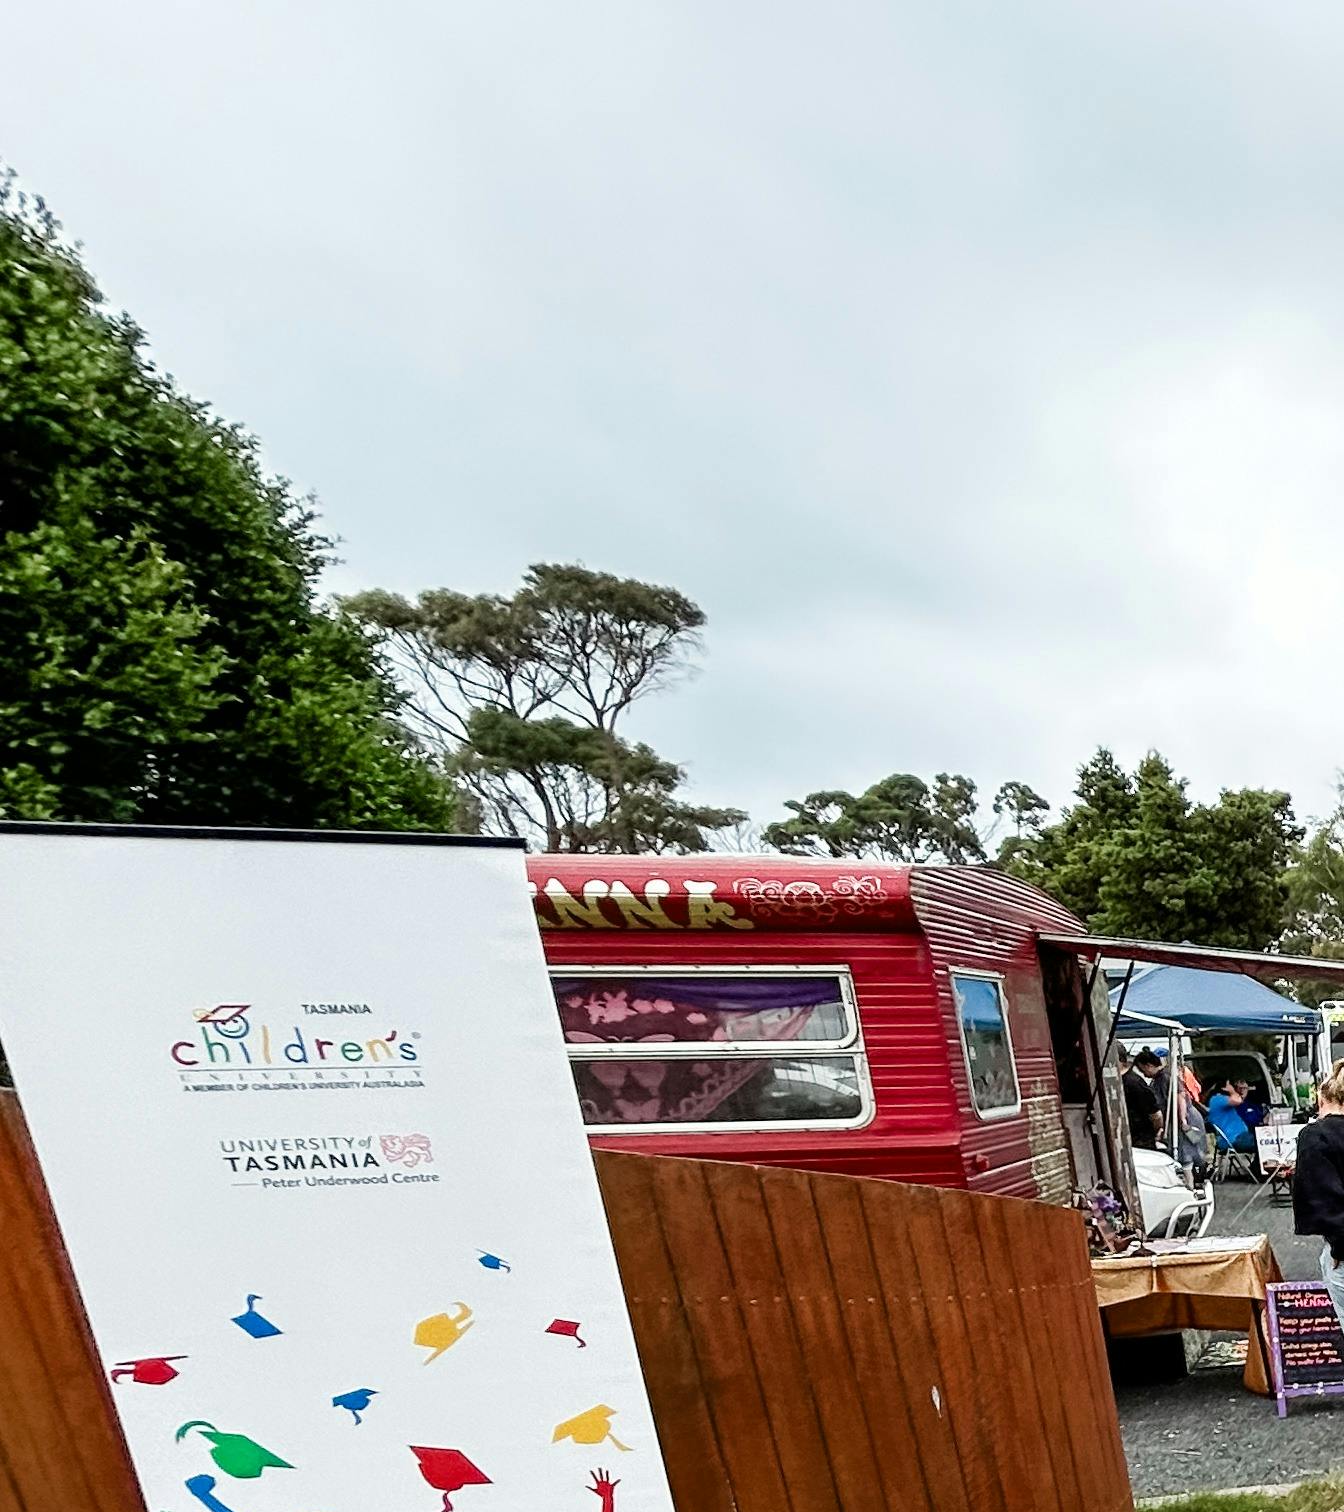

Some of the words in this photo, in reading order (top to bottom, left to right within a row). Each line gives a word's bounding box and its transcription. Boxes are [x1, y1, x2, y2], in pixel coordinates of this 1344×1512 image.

[301, 1003, 373, 1015] TASMANIA
[171, 1022, 418, 1066] children's
[220, 1137, 355, 1153] UNIVERSITY
[358, 1136, 373, 1147] of
[223, 1153, 380, 1172] TASMANIA
[262, 1177, 302, 1188] Peter
[305, 1174, 388, 1187] Underwood
[393, 1173, 440, 1184] Centre
